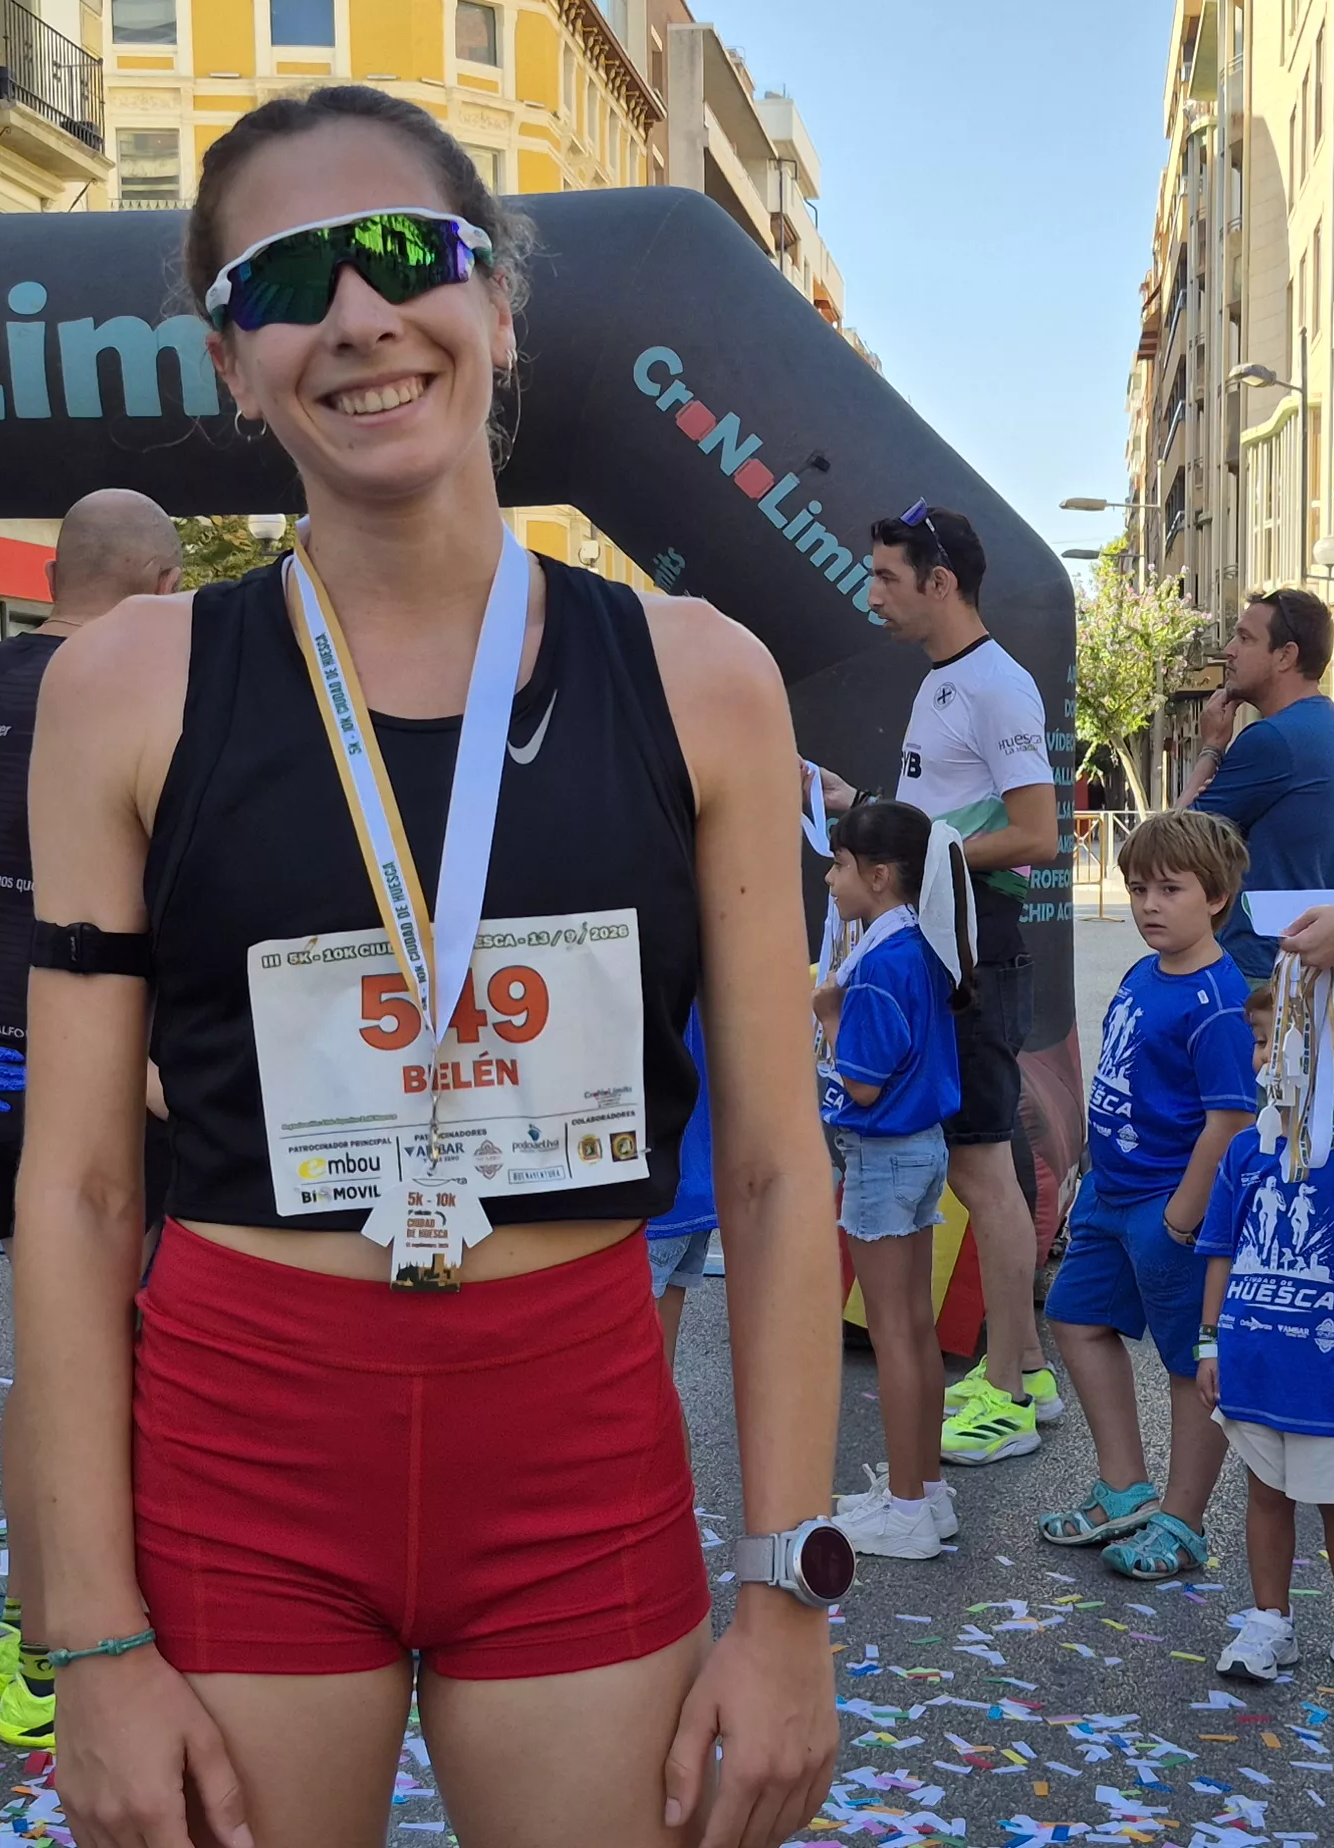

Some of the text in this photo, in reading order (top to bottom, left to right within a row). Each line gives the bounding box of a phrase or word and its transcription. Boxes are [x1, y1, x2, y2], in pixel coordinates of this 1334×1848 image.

[325, 667, 338, 680] DE
[328, 681, 349, 715] CIUDAD
[383, 862, 406, 902] HUESCA
[395, 905, 410, 920] DE
[401, 922, 421, 962] CIUDAD
[262, 954, 281, 968] III
[287, 951, 312, 965] 5K
[322, 946, 357, 962] 10K
[402, 1051, 519, 1094] BELÉN
[571, 1110, 636, 1126] COLABORADORES
[288, 1137, 392, 1153] PATROCINADOR PRINCIPAL
[298, 1152, 381, 1180] embou
[1244, 1275, 1275, 1285] CIUDAD
[1227, 1280, 1334, 1310] HUESCA
